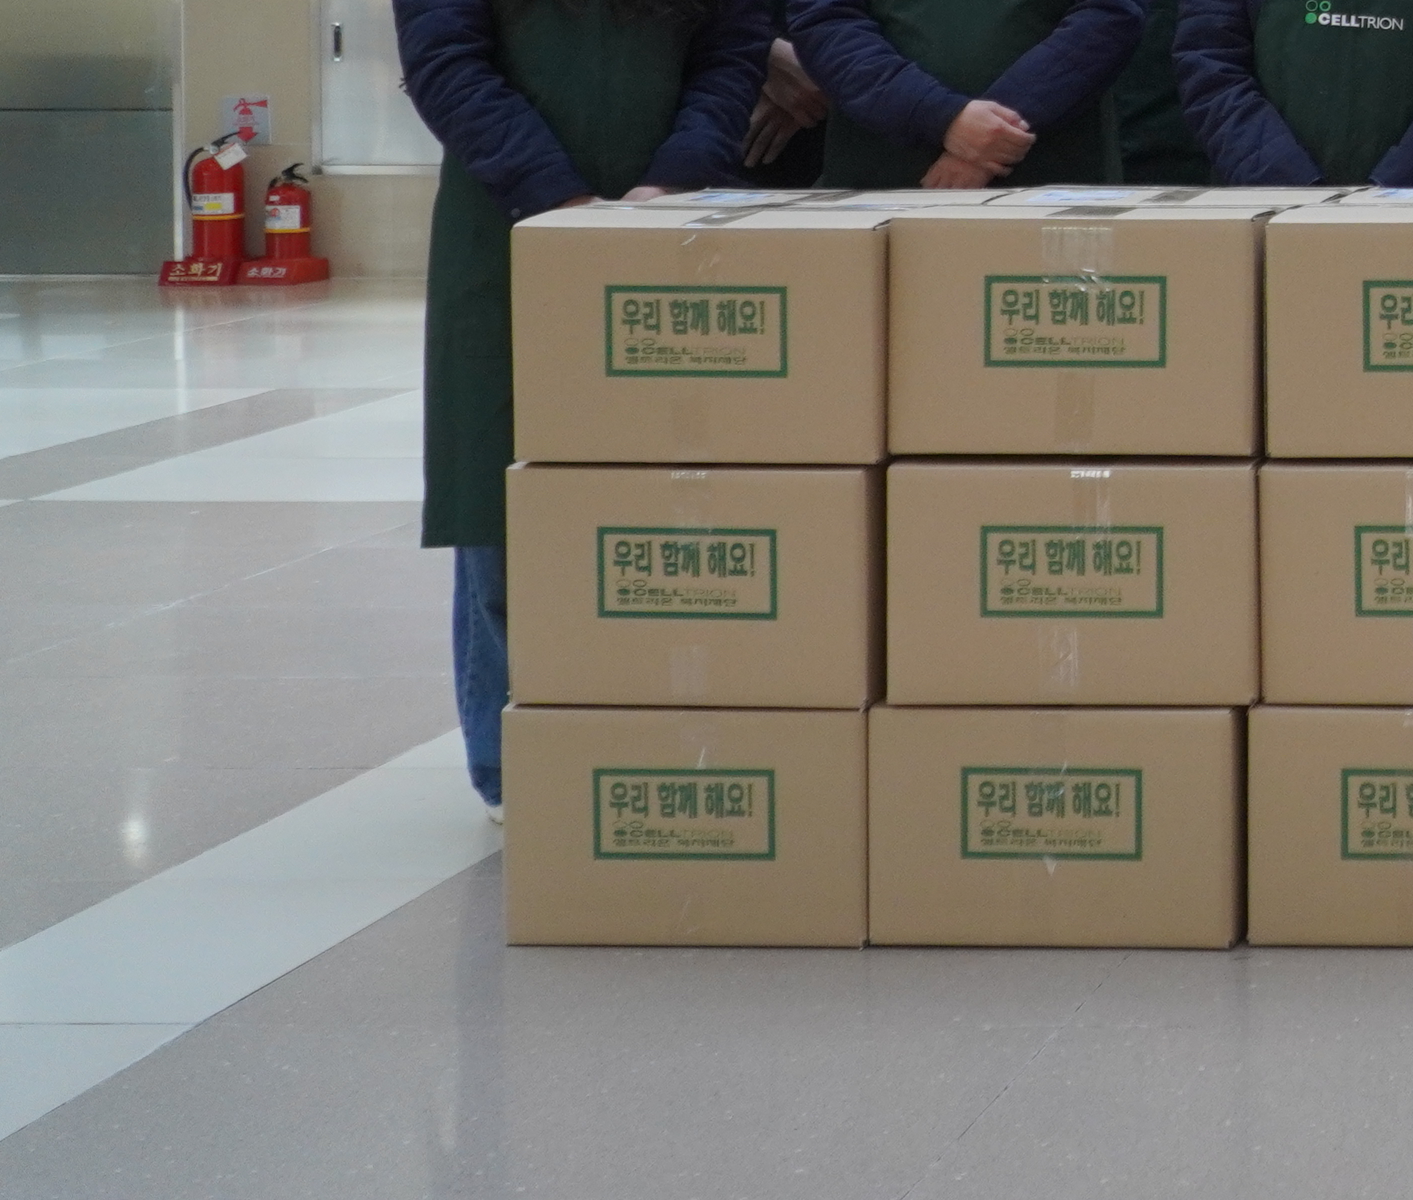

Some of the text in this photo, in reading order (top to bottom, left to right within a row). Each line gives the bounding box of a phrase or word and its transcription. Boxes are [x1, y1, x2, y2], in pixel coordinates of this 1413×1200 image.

[1318, 12, 1404, 31] CELLTRION
[169, 262, 223, 277] 소화기
[247, 266, 287, 278] 소화기
[621, 299, 767, 336] 우리 함께 해요!
[1000, 289, 1145, 326] 우리 함께 해요!
[613, 540, 756, 578] 우리 함께 해요!
[997, 539, 1142, 576] 우리 함께 해요!
[1371, 539, 1410, 576] 우리
[609, 782, 754, 818] 우리 함께 해요!
[977, 780, 1016, 818] 우리
[1072, 780, 1121, 818] 해요!
[1358, 782, 1397, 818] 우리
